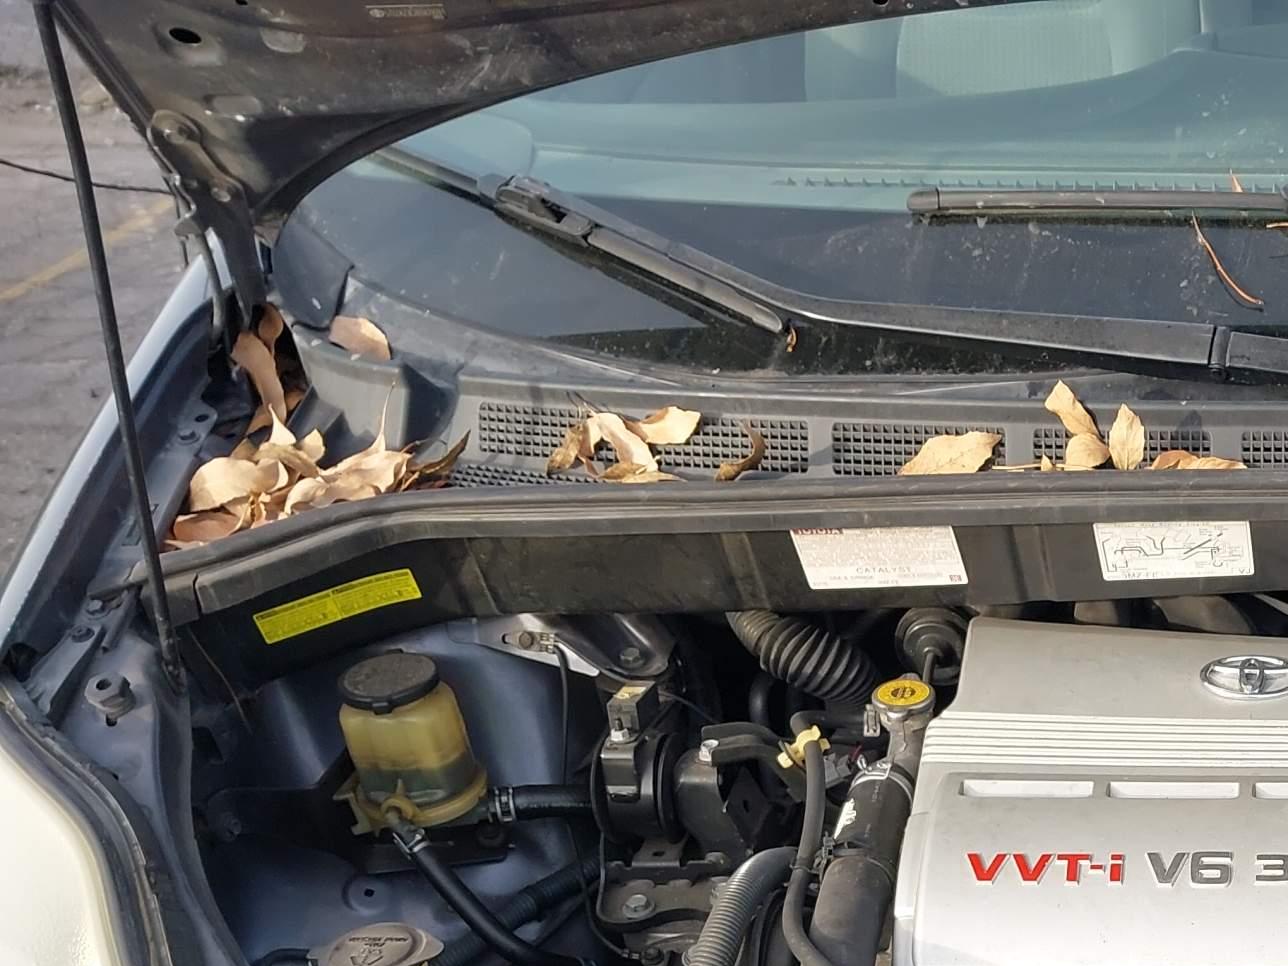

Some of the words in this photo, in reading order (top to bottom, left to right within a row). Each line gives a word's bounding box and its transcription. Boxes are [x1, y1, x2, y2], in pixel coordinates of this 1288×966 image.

[855, 566, 912, 575] CATALYST
[966, 851, 1125, 885] VVT-i
[1145, 850, 1234, 889] V6
